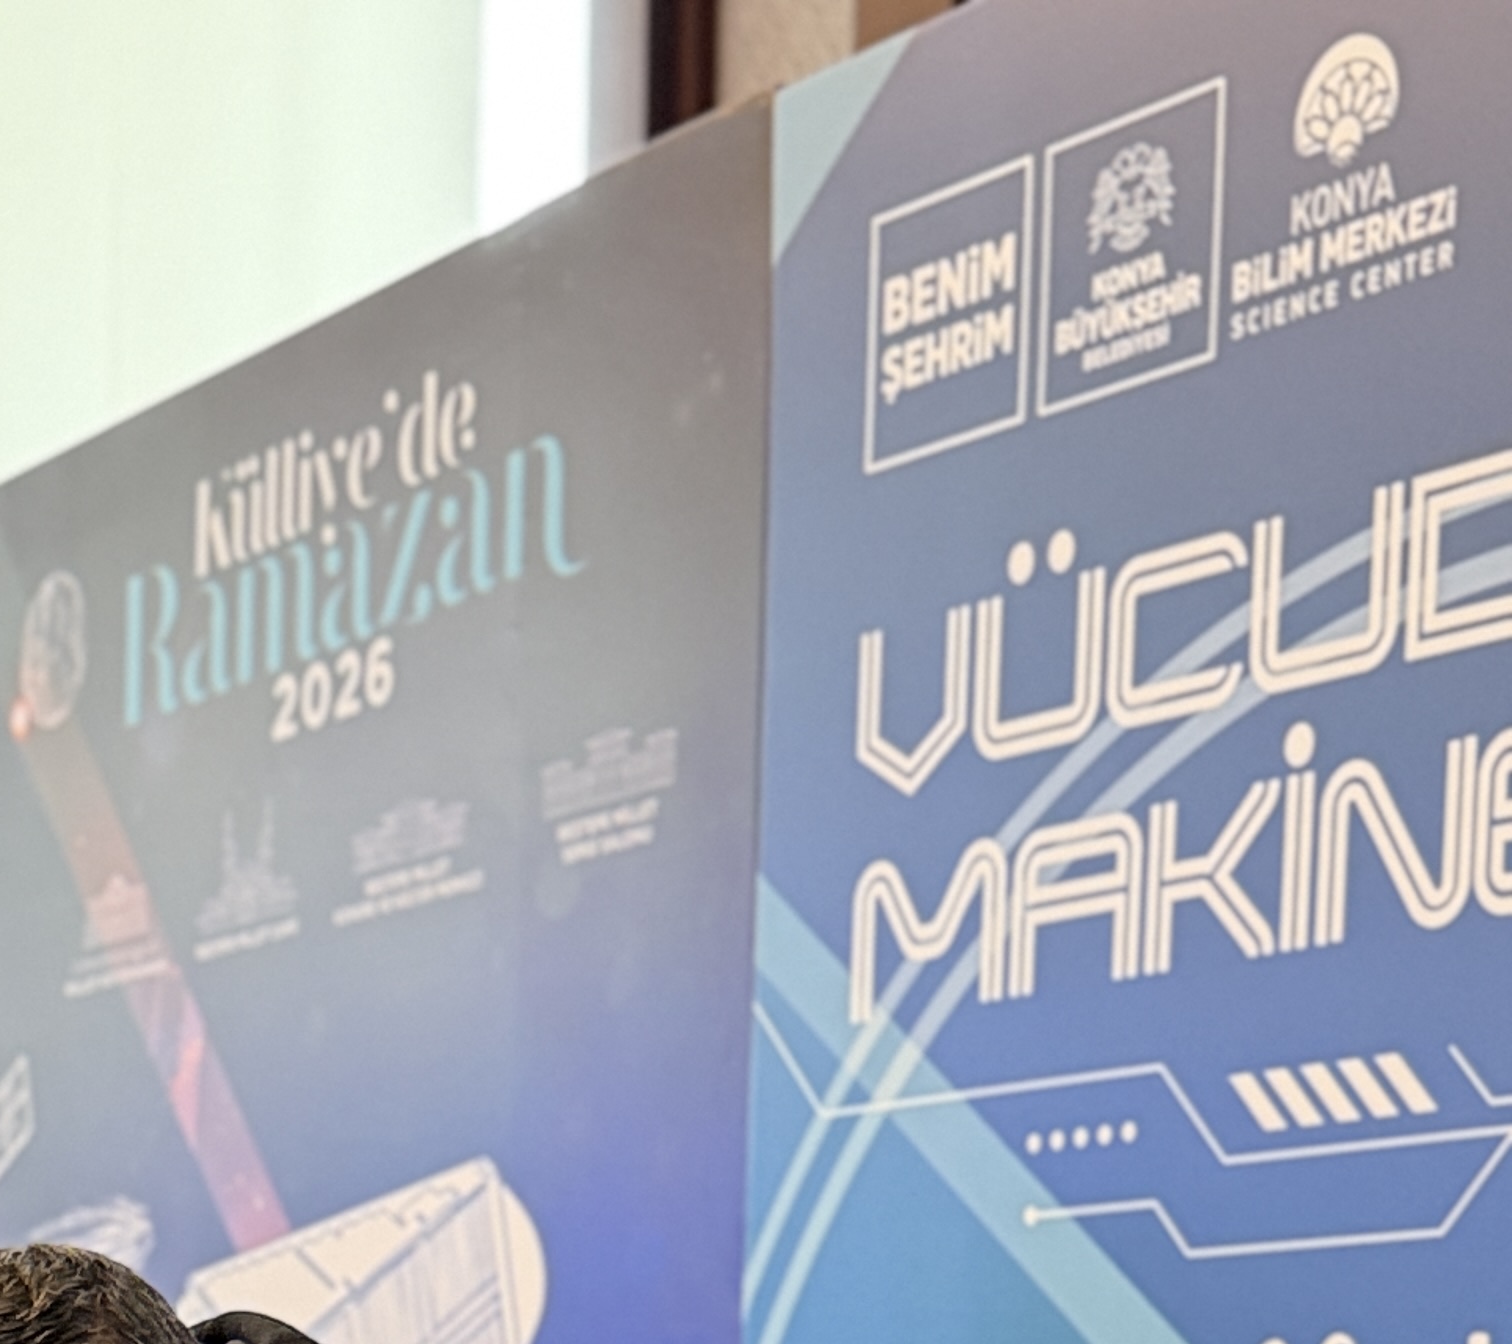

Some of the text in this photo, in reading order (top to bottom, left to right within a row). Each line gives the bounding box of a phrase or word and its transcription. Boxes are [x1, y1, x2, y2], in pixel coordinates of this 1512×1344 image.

[1231, 185, 1458, 304] BİLİM MERKEZİ
[1290, 162, 1396, 236] KONYA
[881, 231, 1017, 336] BENİM
[1230, 240, 1456, 341] SCIENCE CENTER
[881, 303, 1015, 405] ŞEHRİM
[124, 434, 586, 728] Ramazan
[270, 636, 395, 743] 2026
